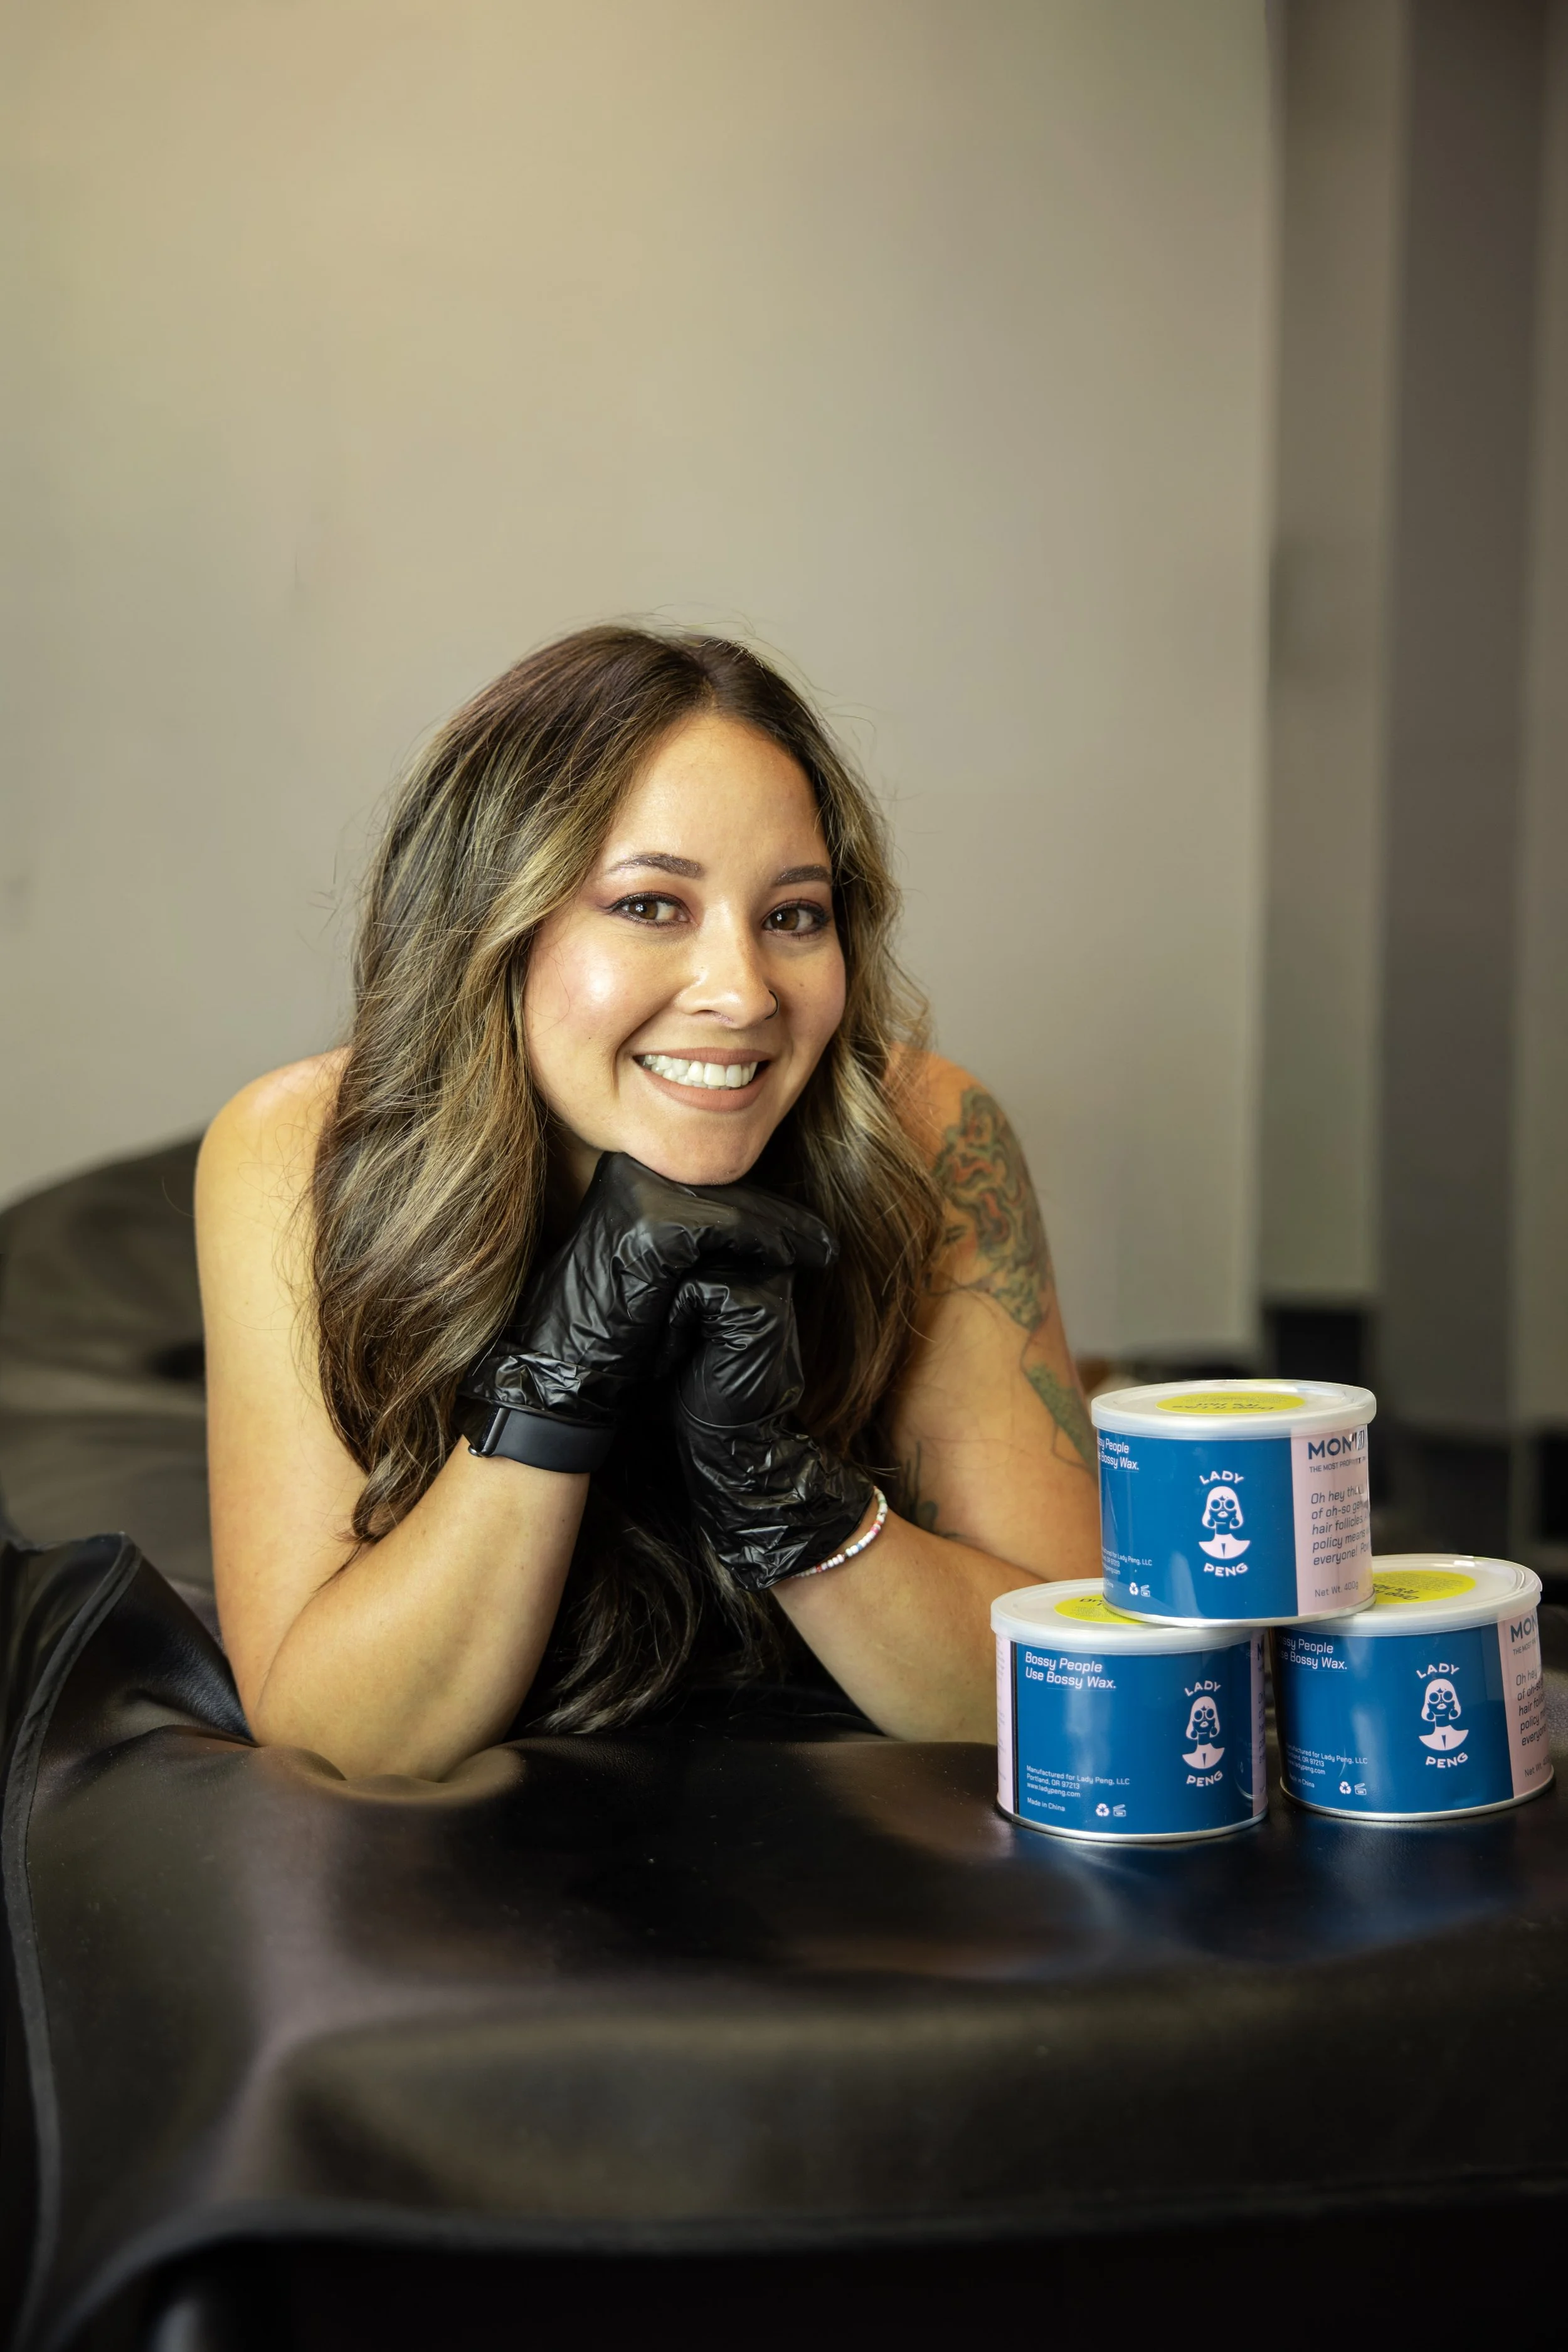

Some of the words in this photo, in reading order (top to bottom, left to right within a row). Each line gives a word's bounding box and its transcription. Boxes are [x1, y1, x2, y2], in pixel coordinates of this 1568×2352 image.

[1105, 1438, 1130, 1454] People
[1101, 1451, 1118, 1469] Bossy
[1120, 1456, 1139, 1470] Wax.
[1309, 1465, 1322, 1473] THE
[1323, 1462, 1338, 1471] MOST
[1199, 1470, 1244, 1485] LADY
[1311, 1493, 1325, 1504] Oh
[1328, 1490, 1345, 1502] hey
[1311, 1507, 1323, 1520] of
[1326, 1505, 1351, 1517] oh-so
[1312, 1522, 1333, 1535] hair
[1312, 1535, 1343, 1554] policy
[1345, 1529, 1365, 1544] means
[1118, 1554, 1128, 1563] Lady
[1313, 1545, 1358, 1565] everyone!
[1204, 1562, 1248, 1577] PENG
[1315, 1589, 1330, 1597] Net
[1298, 1638, 1333, 1655] People
[1025, 1651, 1056, 1671] Bossy
[1059, 1658, 1103, 1674] People
[1290, 1651, 1318, 1669] Bossy
[1322, 1656, 1347, 1670] Wax.
[1025, 1666, 1044, 1681] Use
[1047, 1671, 1083, 1689] Bossy
[1088, 1675, 1116, 1688] Wax.
[1416, 1663, 1460, 1679] LADY
[1516, 1673, 1526, 1686] Oh
[1185, 1680, 1222, 1697] LADY
[1517, 1688, 1525, 1701] of
[1519, 1702, 1532, 1716] hair
[1520, 1716, 1540, 1734] policy
[1310, 1758, 1325, 1767] 97213
[1321, 1753, 1335, 1762] Lady
[1425, 1752, 1468, 1768] PENG
[1027, 1765, 1064, 1779] Manufactured
[1077, 1775, 1093, 1784] Lady
[1187, 1770, 1223, 1787] PENG
[1027, 1783, 1081, 1798] www.ladypeng.com
[1062, 1781, 1080, 1789] 97213
[1301, 1779, 1315, 1788] China
[1027, 1797, 1041, 1807] Made
[1048, 1803, 1066, 1811] China
